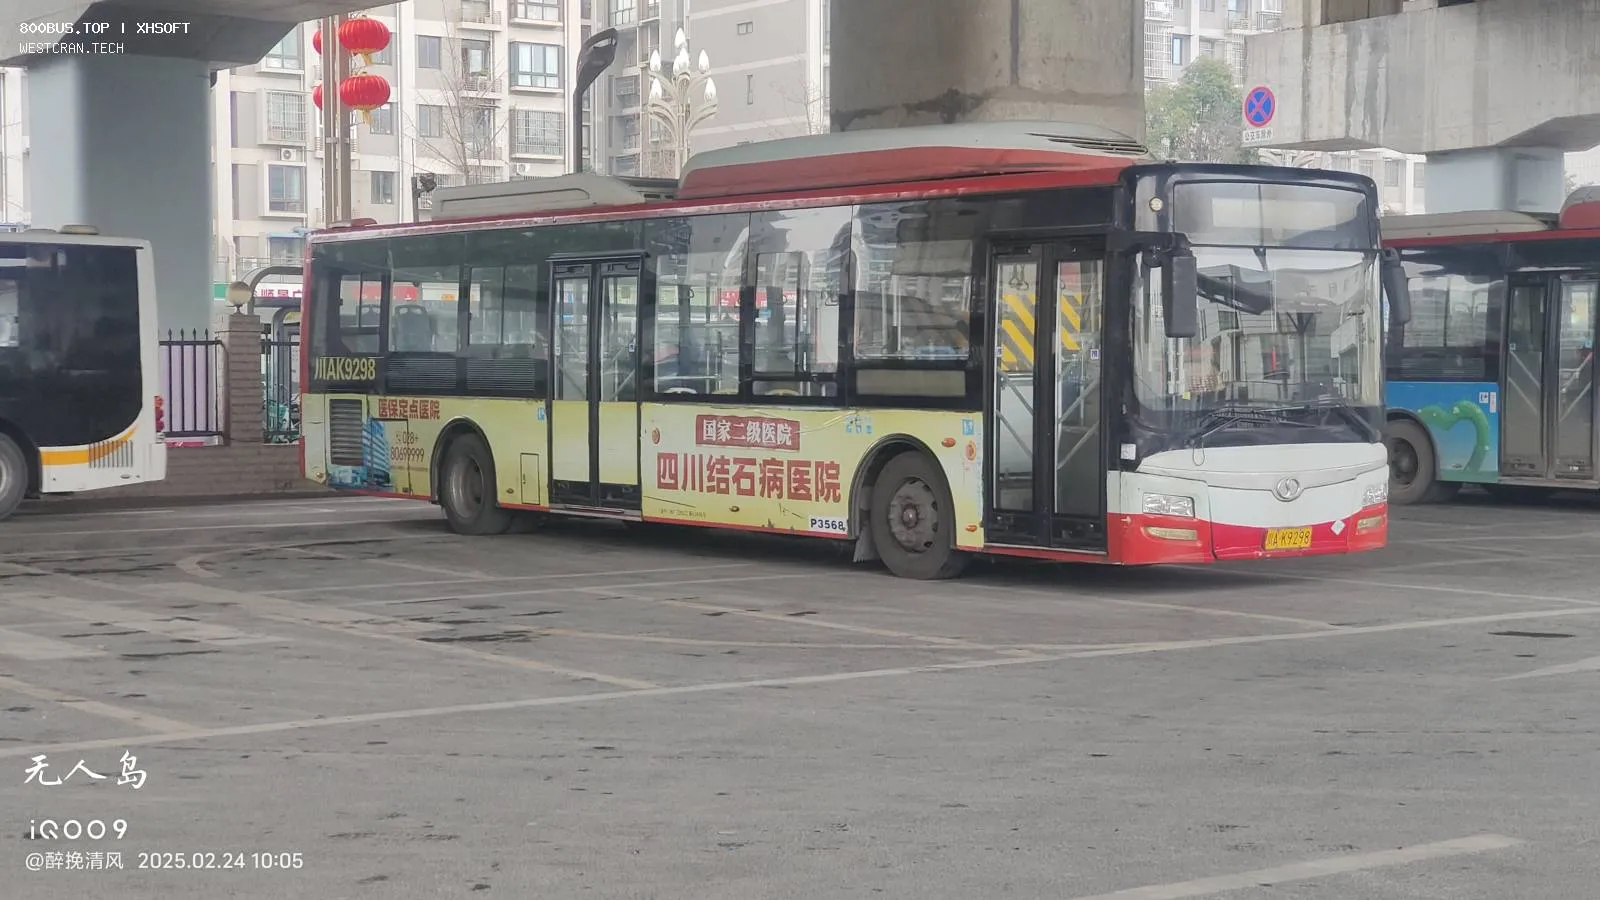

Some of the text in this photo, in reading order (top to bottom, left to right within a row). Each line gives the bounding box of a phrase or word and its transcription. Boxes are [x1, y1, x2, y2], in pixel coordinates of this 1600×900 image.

[314, 358, 376, 380] 川AK9298
[378, 399, 440, 419] 医保定点医院
[702, 419, 792, 445] 国家二级医院
[656, 452, 841, 503] 四川结石病医院
[810, 518, 844, 530] P3568
